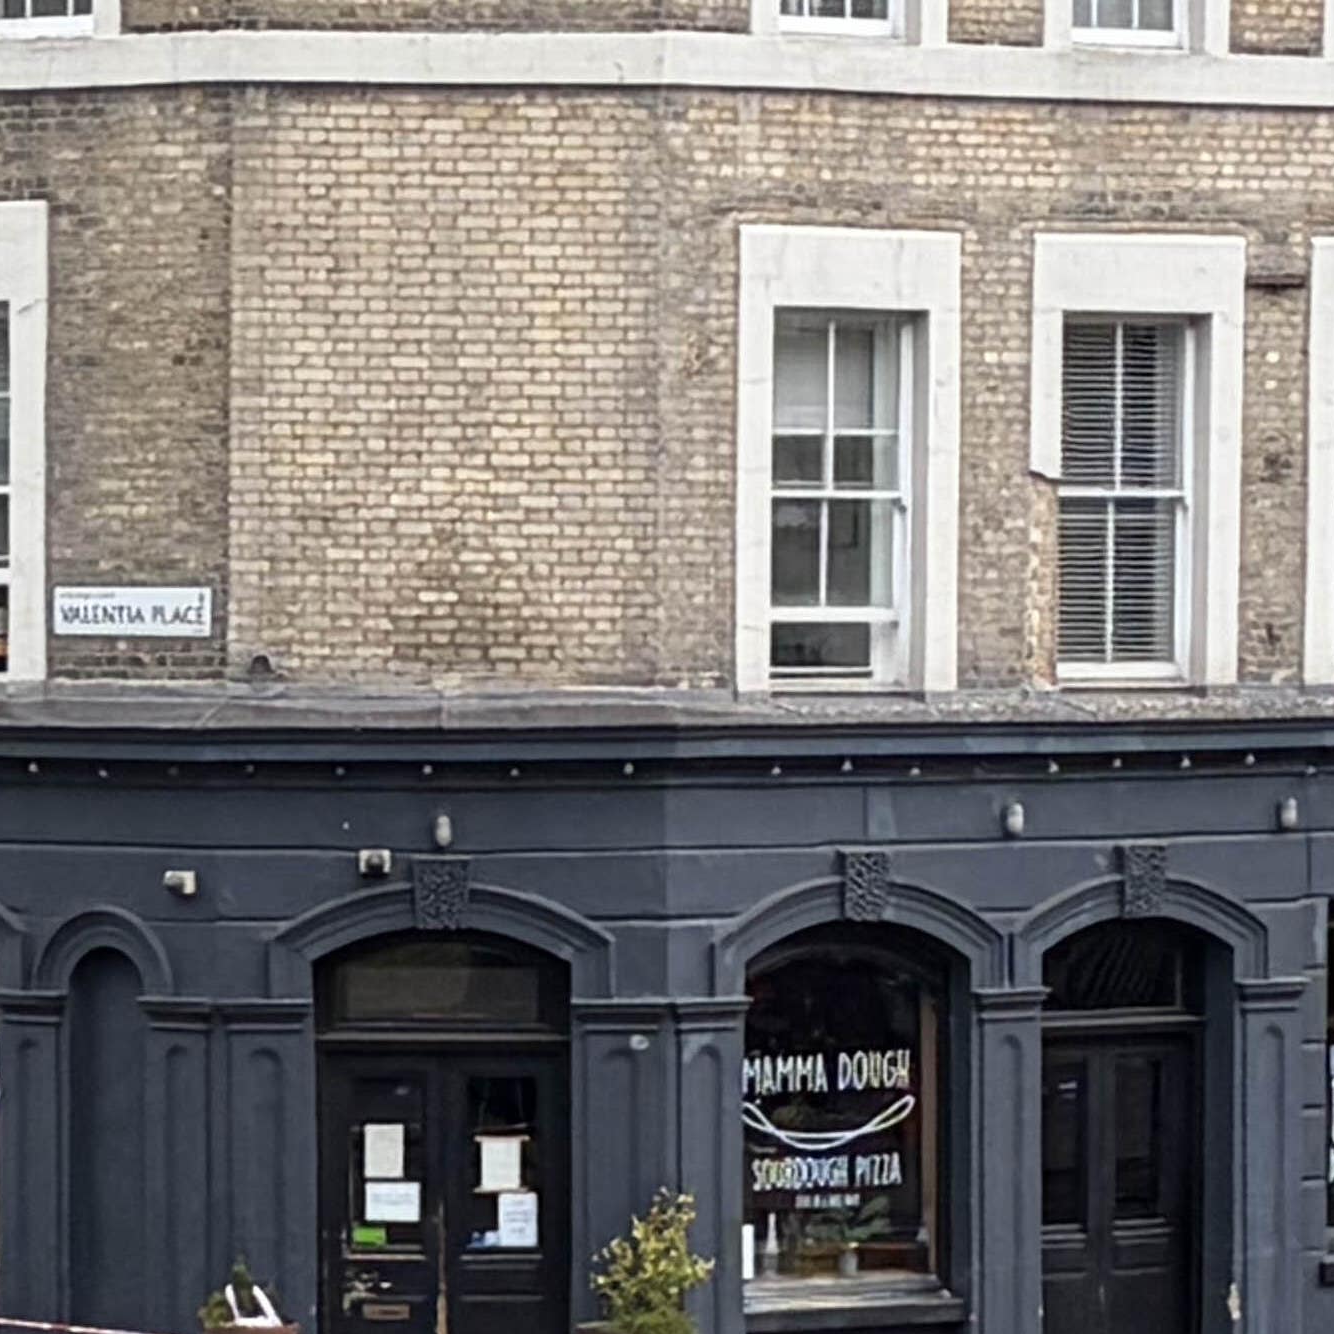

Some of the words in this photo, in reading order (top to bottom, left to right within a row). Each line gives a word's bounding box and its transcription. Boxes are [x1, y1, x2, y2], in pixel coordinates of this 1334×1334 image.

[60, 605, 146, 624] VALENTIA
[151, 604, 205, 626] PLACE
[742, 1053, 828, 1095] MAMMA
[837, 1050, 910, 1090] DOUGH
[752, 1155, 849, 1191] SOURDOUGH
[855, 1152, 903, 1187] PIZZA
